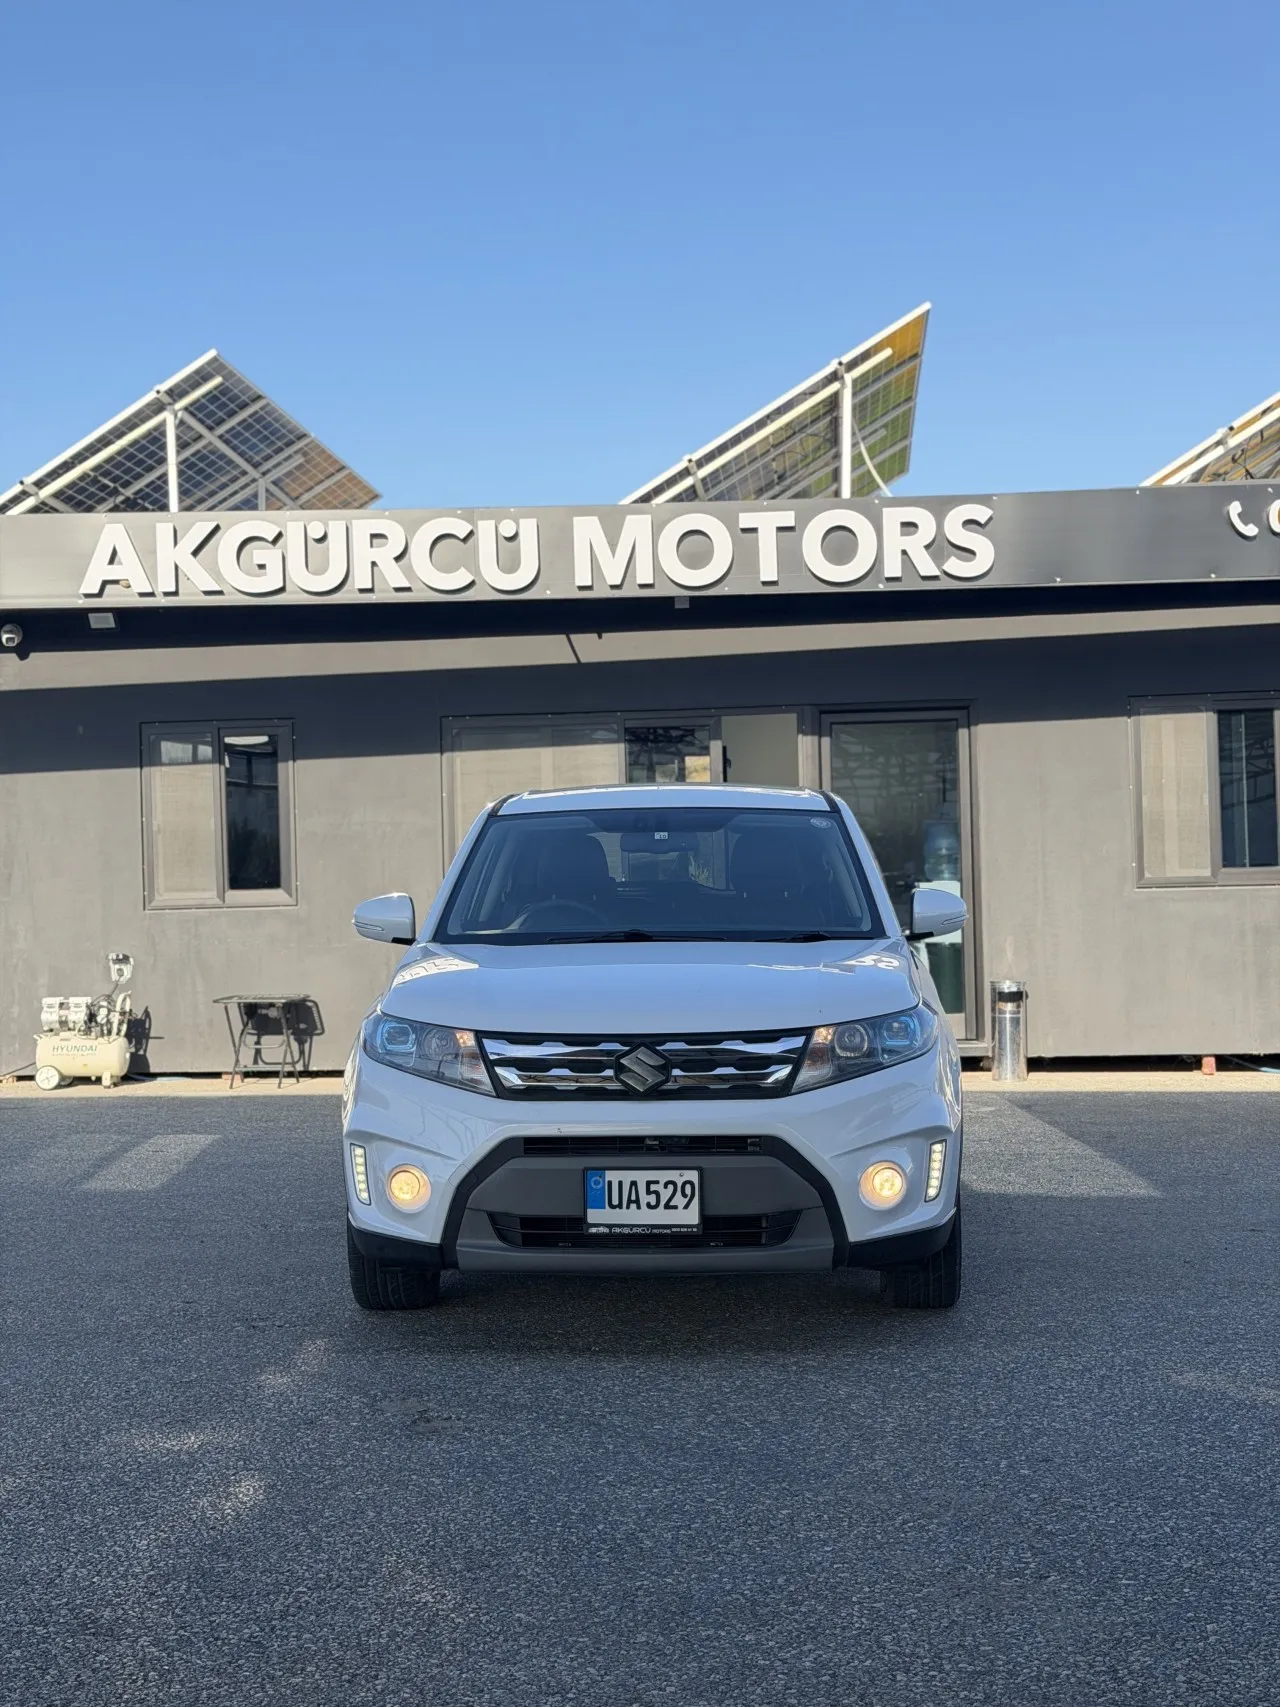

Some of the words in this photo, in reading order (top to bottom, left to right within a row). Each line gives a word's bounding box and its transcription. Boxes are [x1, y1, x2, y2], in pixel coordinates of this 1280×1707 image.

[79, 516, 541, 599] AKGÜRCÜ
[572, 503, 997, 589] MOTORS
[52, 1044, 98, 1053] HYUNDAI
[607, 1179, 696, 1210] UA529
